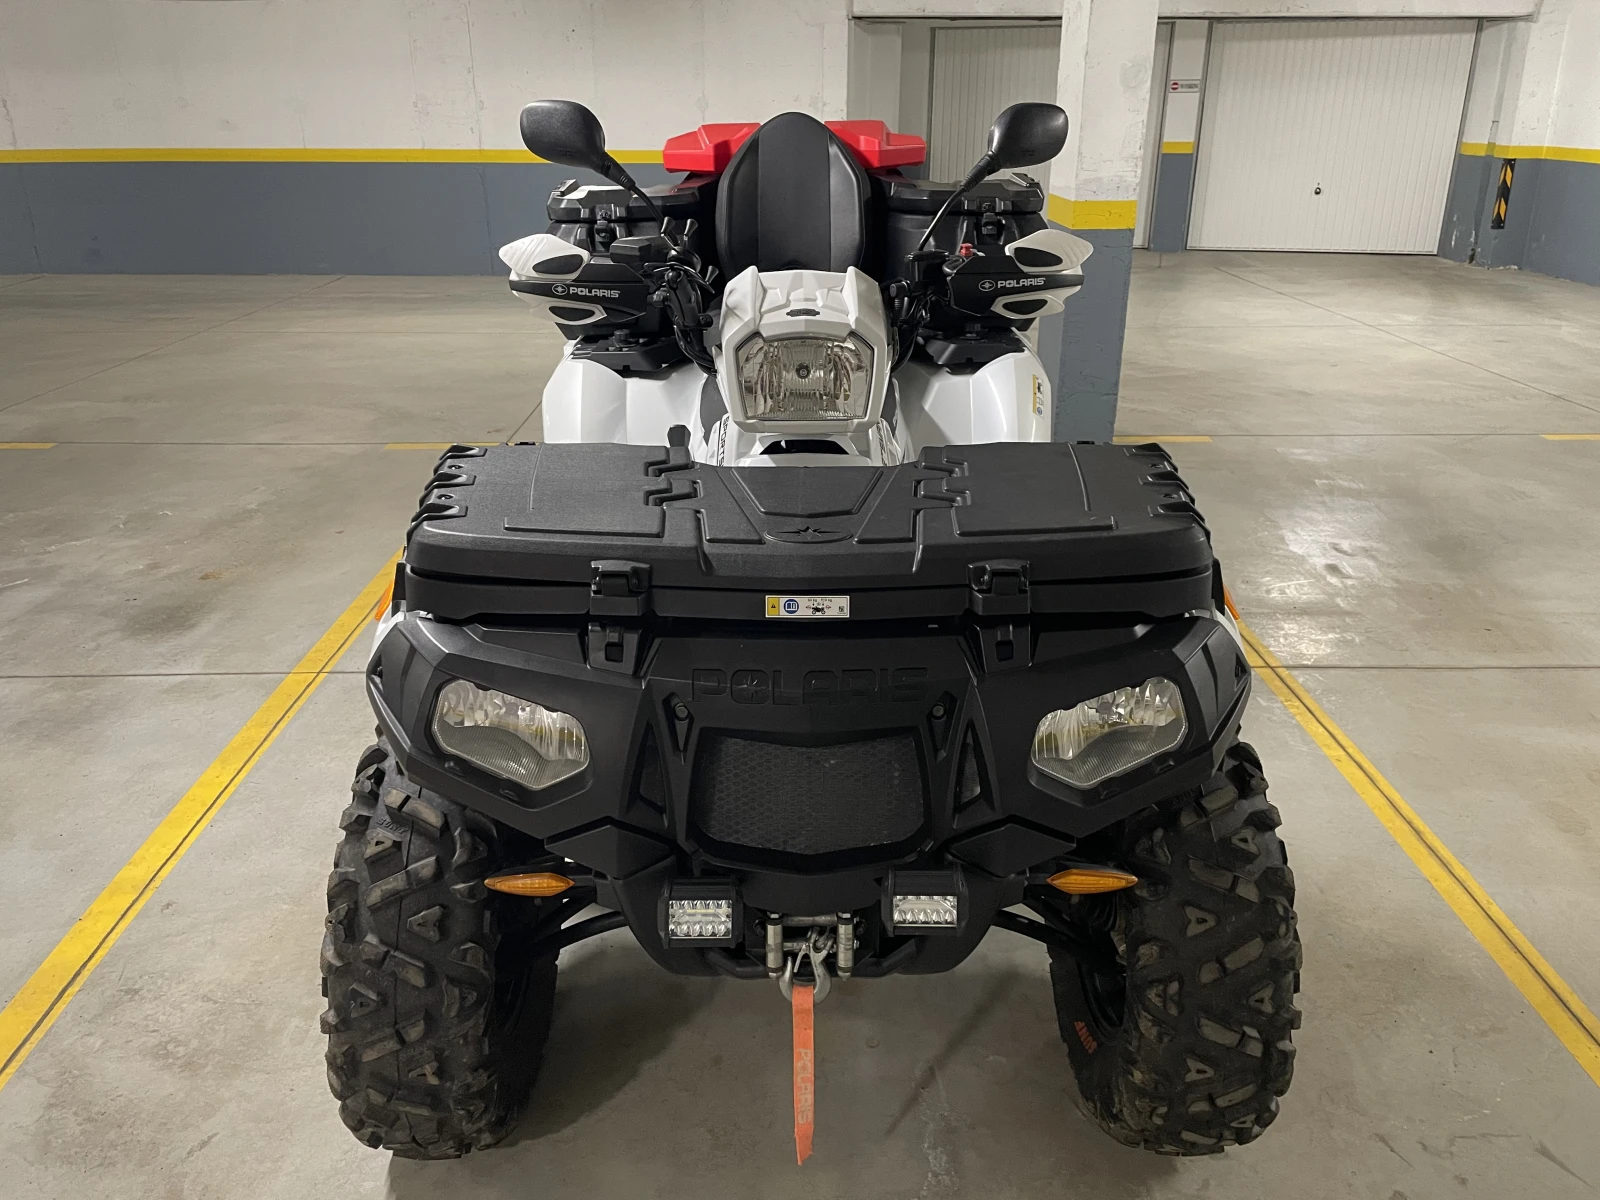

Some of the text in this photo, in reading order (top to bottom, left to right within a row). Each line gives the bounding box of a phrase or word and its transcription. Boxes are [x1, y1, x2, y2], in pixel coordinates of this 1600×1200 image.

[569, 287, 621, 298] POLARIS
[997, 277, 1046, 289] POLARIS
[719, 415, 730, 467] SPORTS
[692, 668, 928, 704] POLARIS
[797, 1048, 812, 1124] POLARIS
